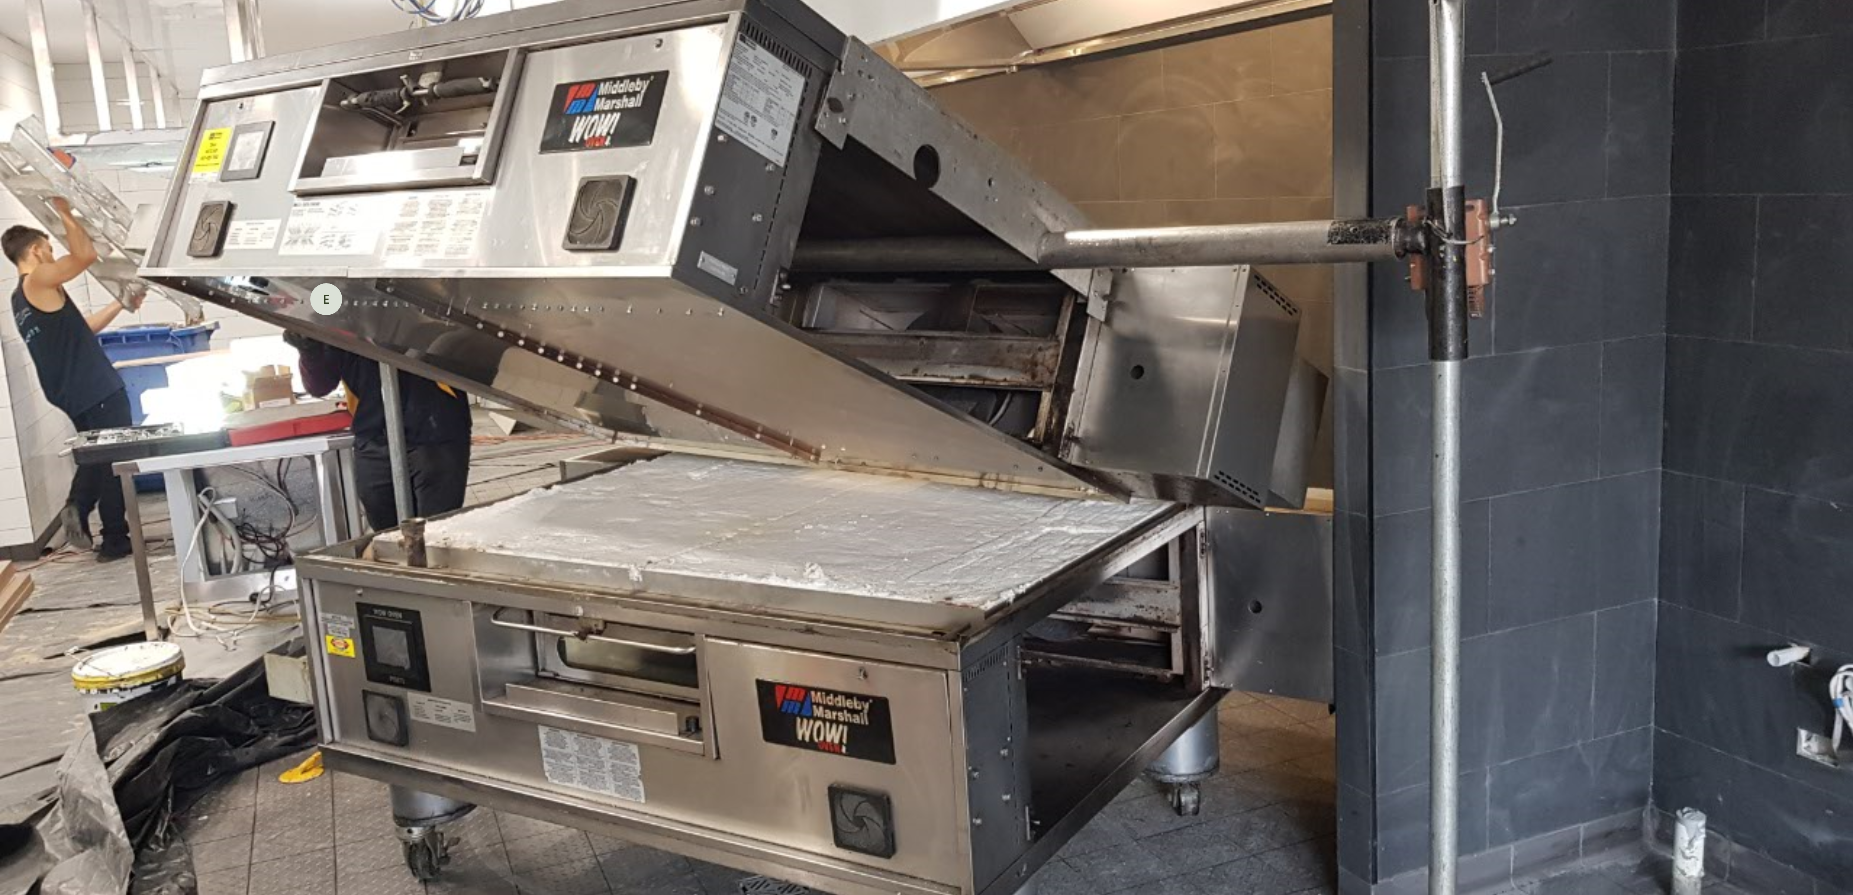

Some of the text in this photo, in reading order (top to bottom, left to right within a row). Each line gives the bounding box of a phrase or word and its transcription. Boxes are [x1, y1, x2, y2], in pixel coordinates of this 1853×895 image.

[598, 79, 650, 97] Middleby
[594, 94, 643, 111] Marshall
[568, 112, 621, 145] WOW!
[810, 690, 869, 713] Middleby
[811, 705, 869, 725] Marshall
[795, 717, 848, 753] WOW!
